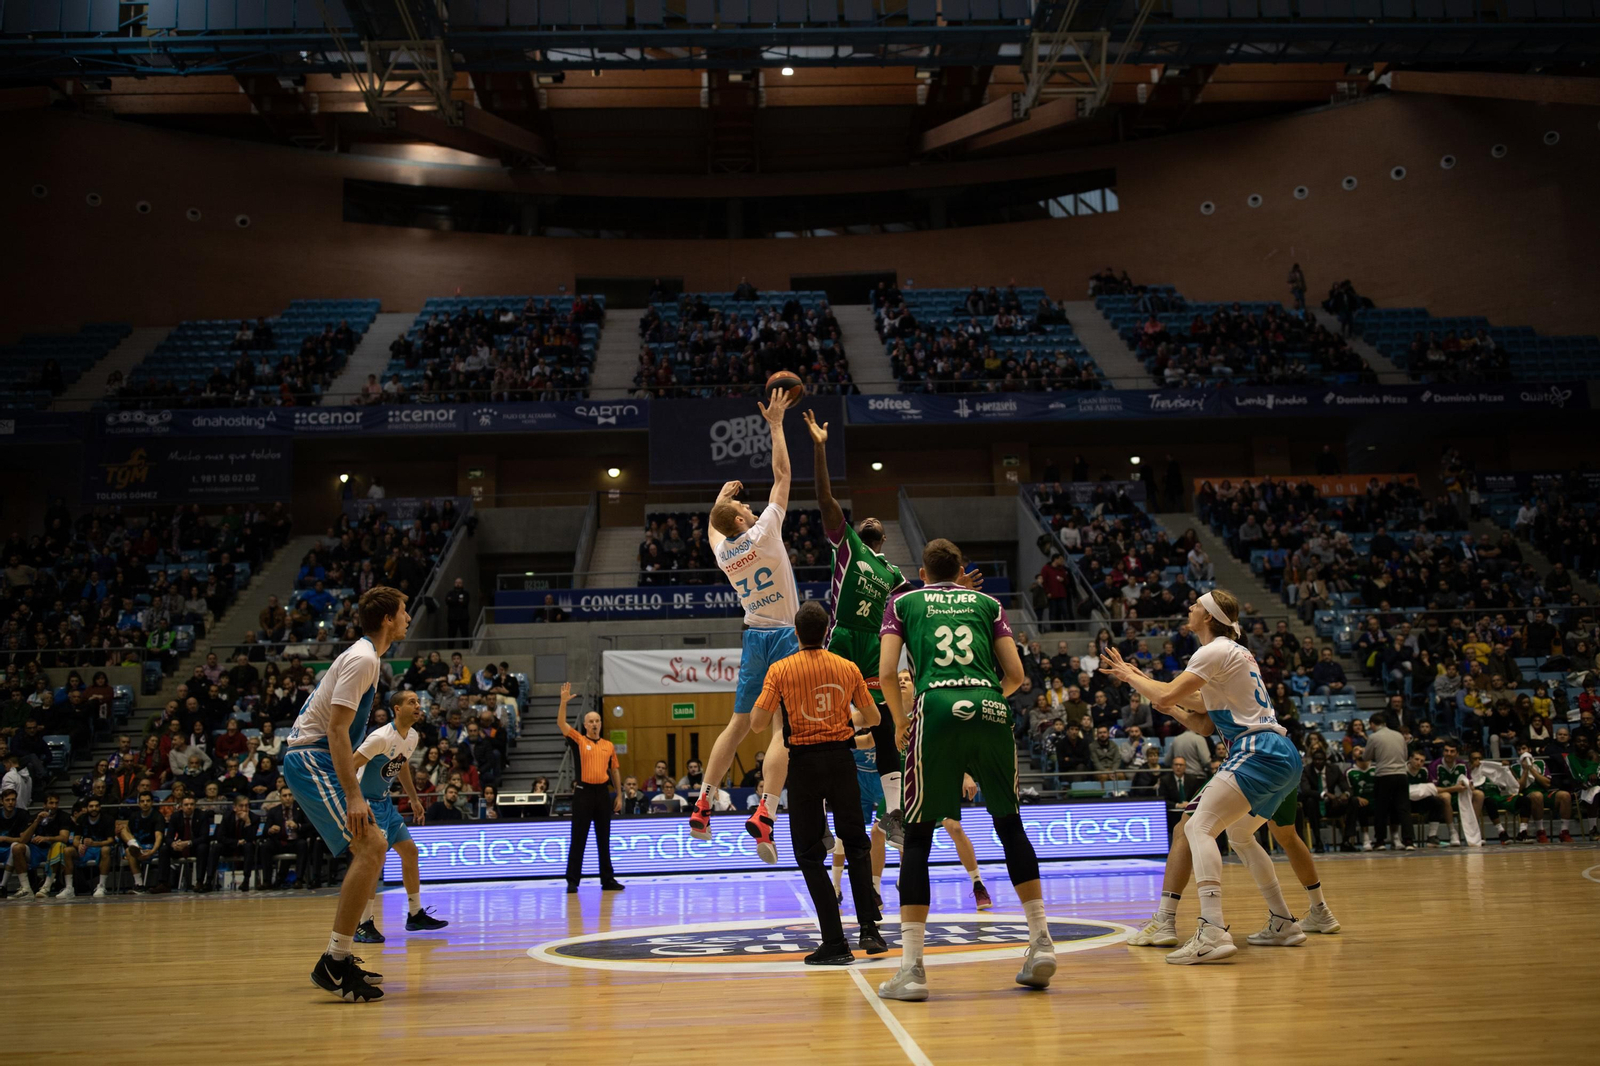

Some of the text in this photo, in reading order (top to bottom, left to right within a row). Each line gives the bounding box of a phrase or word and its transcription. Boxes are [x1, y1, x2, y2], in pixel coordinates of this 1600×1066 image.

[868, 398, 911, 409] Softee
[1382, 395, 1408, 404] Pizza
[1480, 393, 1504, 402] Pizza
[308, 412, 363, 424] cenor
[401, 409, 456, 422] cenor
[193, 416, 265, 429] dinahosting
[201, 475, 216, 483] 981
[245, 474, 257, 482] 02
[580, 594, 662, 612] CONCELLO
[673, 593, 694, 609] DE
[924, 593, 977, 605] WILTJER
[856, 600, 872, 617] 26
[934, 625, 974, 667] 33
[661, 656, 741, 686] La Vo
[928, 675, 992, 689] worten
[815, 693, 831, 713] 31
[982, 699, 1007, 711] COSTA
[982, 706, 996, 715] DEL
